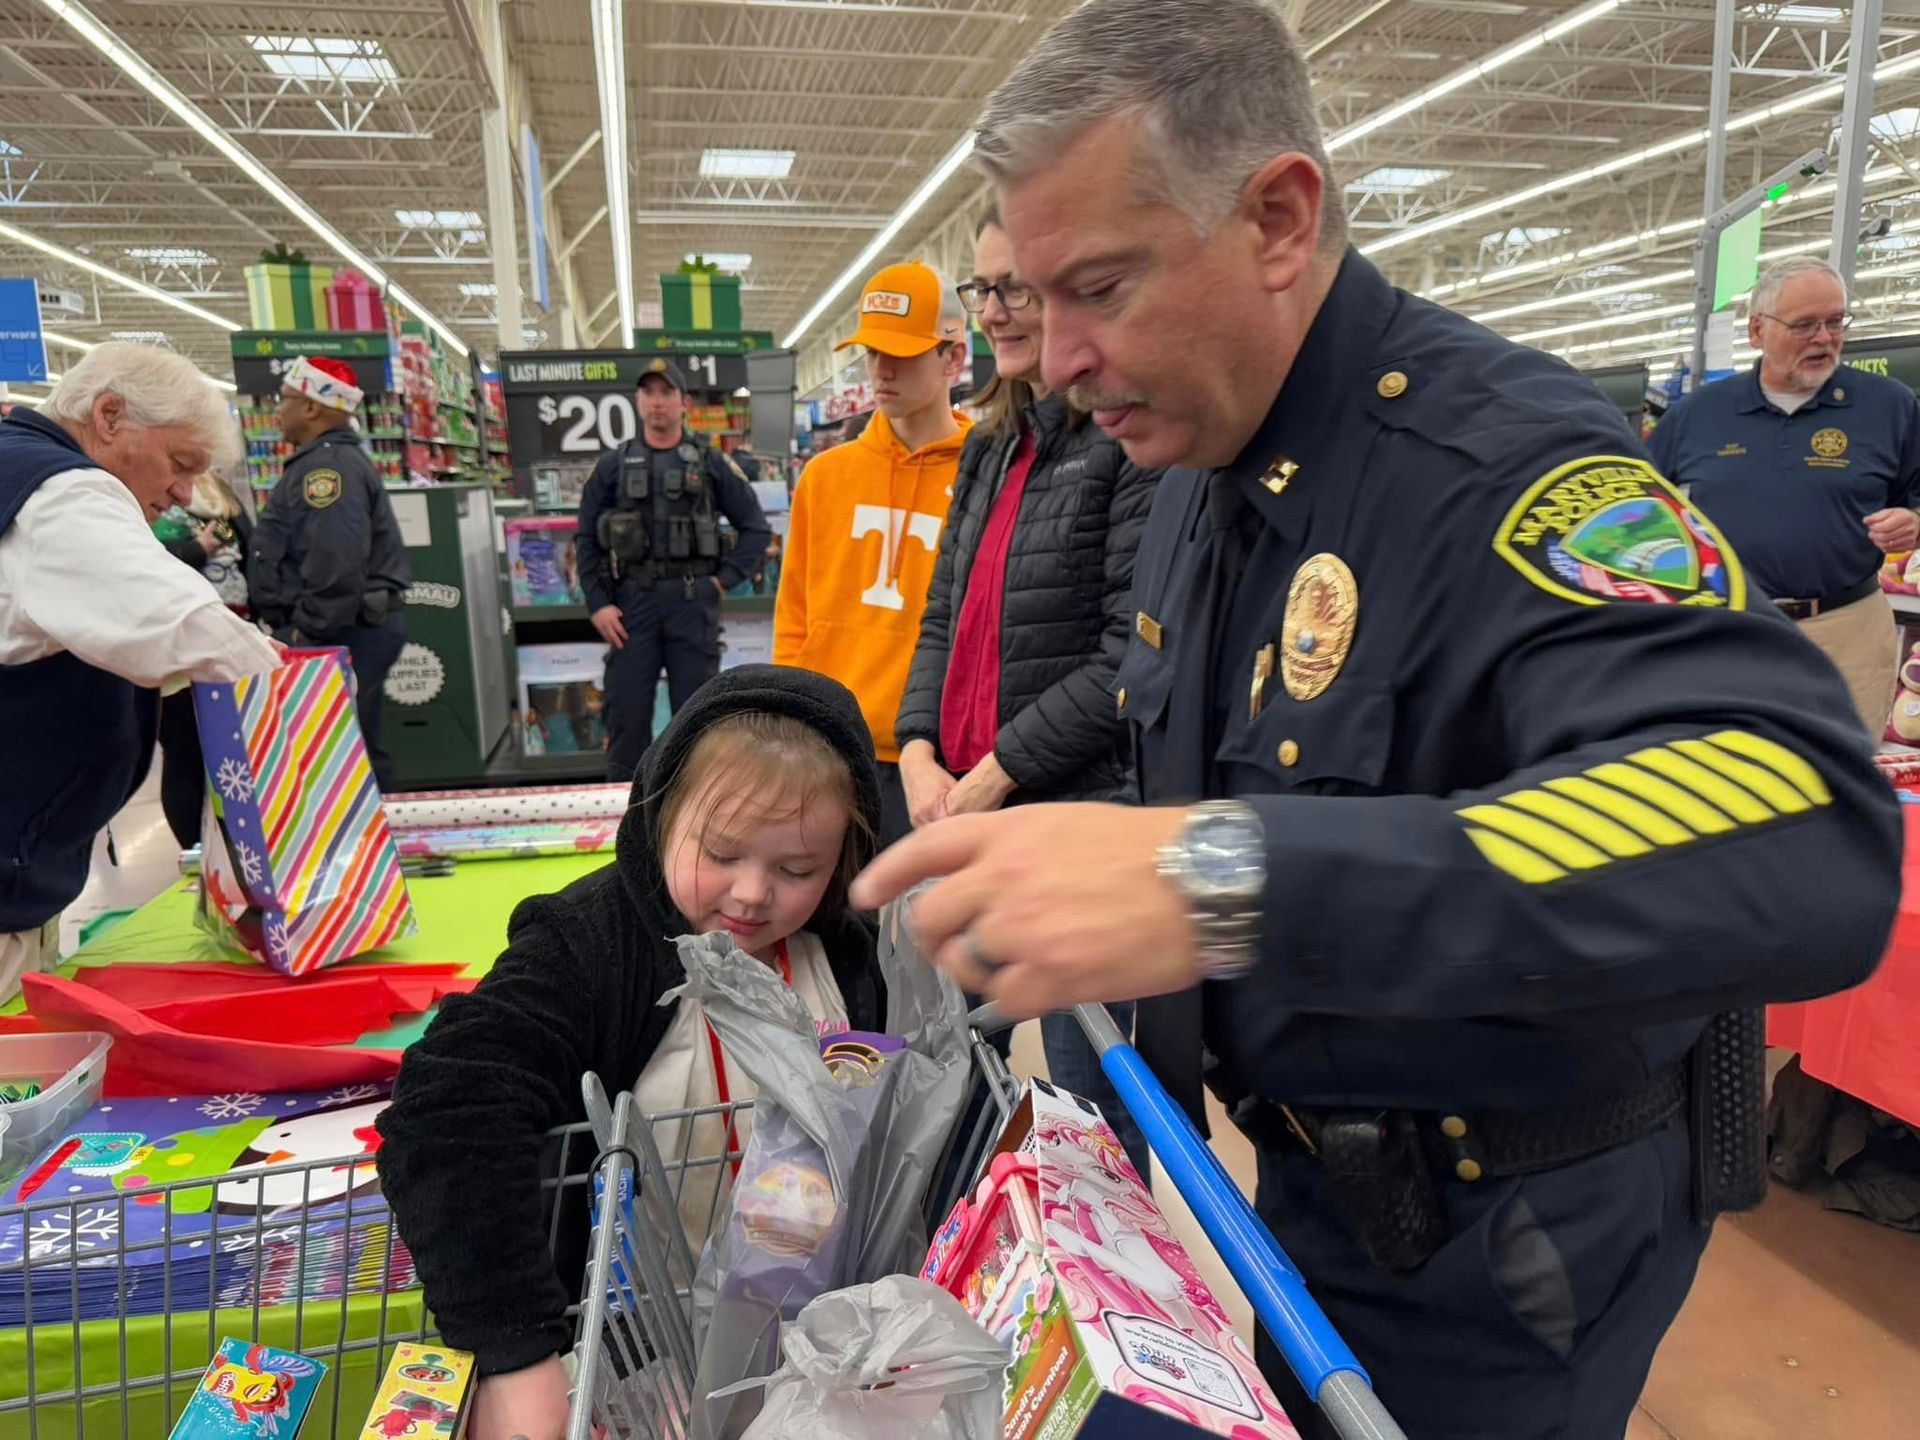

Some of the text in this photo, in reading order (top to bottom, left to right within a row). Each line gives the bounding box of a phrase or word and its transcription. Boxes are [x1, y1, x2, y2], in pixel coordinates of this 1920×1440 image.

[509, 361, 618, 382] LAST MINUTE GIFTS
[688, 355, 717, 386] $1
[537, 393, 636, 452] $20
[1511, 467, 1656, 546] MARYVILLE
[1545, 481, 1648, 535] POLICE
[1030, 1345, 1069, 1411] Carnival
